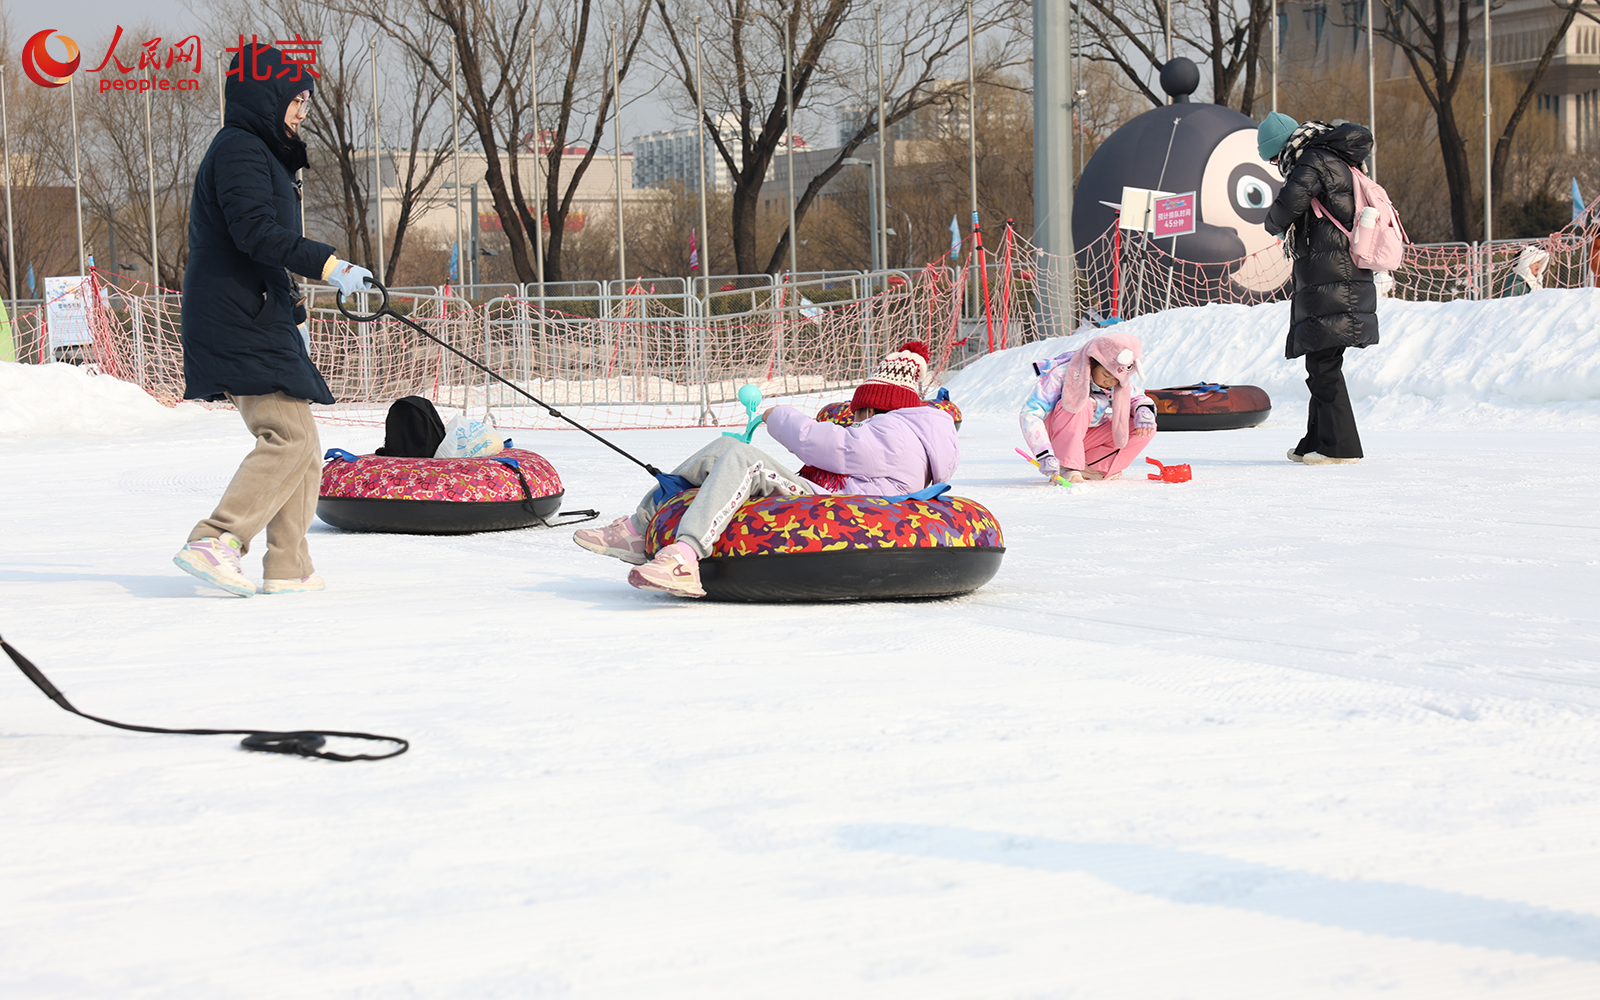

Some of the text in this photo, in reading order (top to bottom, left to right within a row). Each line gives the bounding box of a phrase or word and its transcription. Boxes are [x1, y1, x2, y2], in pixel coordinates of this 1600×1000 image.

[1157, 208, 1191, 221] 预计排队时间
[1164, 218, 1185, 228] 45分钟
